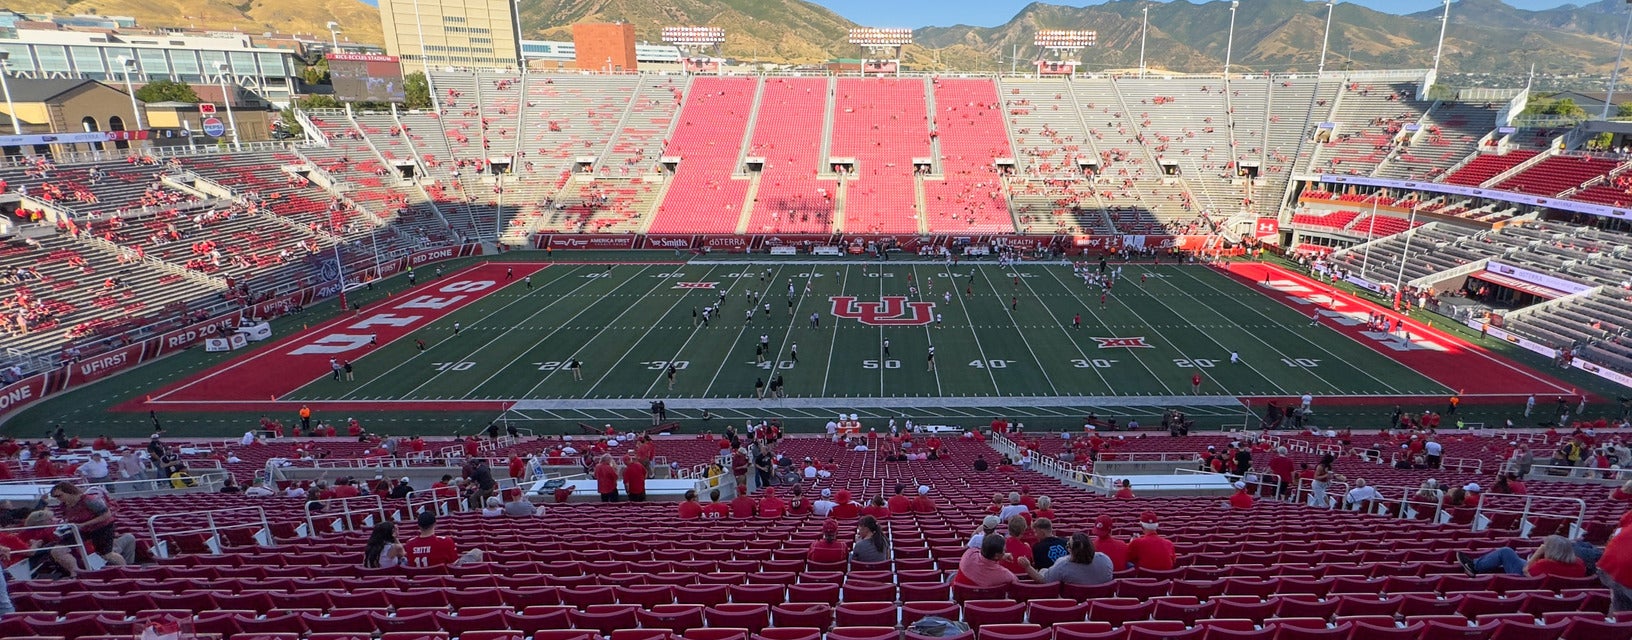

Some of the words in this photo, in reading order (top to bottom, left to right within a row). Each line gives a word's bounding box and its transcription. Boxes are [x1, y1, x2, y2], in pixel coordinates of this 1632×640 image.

[661, 238, 688, 247] Smith's
[413, 255, 426, 264] RED
[428, 249, 453, 260] ZONE
[286, 280, 496, 355] UTES
[169, 331, 196, 348] RED
[199, 318, 232, 337] ZONE
[81, 352, 128, 375] UFIRST
[444, 361, 477, 371] 10
[647, 361, 690, 371] 30
[755, 361, 795, 370] 40
[863, 360, 900, 369] 50
[969, 359, 1007, 369] 40
[1070, 359, 1110, 368] 30
[1173, 358, 1213, 368] 20
[1280, 358, 1318, 367] 10
[412, 546, 431, 554] SMITH
[414, 556, 428, 567] 11
